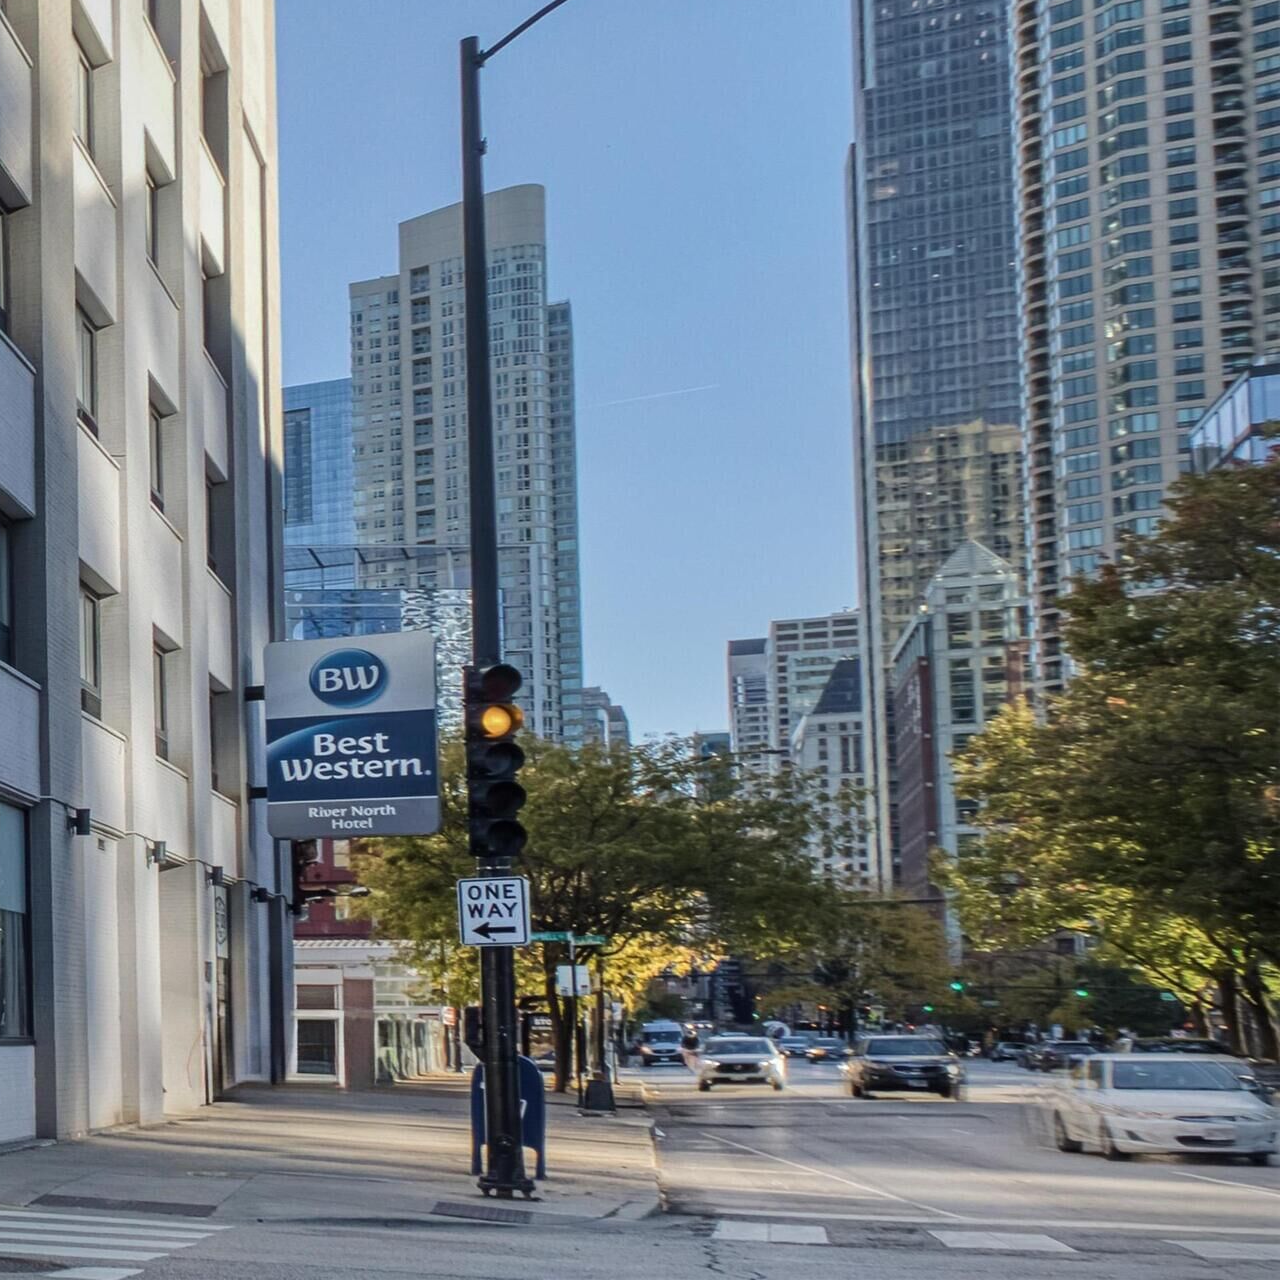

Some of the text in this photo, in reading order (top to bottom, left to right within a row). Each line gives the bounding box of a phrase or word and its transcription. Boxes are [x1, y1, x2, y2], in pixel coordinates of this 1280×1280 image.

[318, 664, 380, 693] BW
[313, 732, 391, 757] Best
[308, 804, 396, 818] River North
[331, 817, 373, 830] Hotel
[467, 884, 517, 900] ONE
[467, 901, 518, 918] WAY
